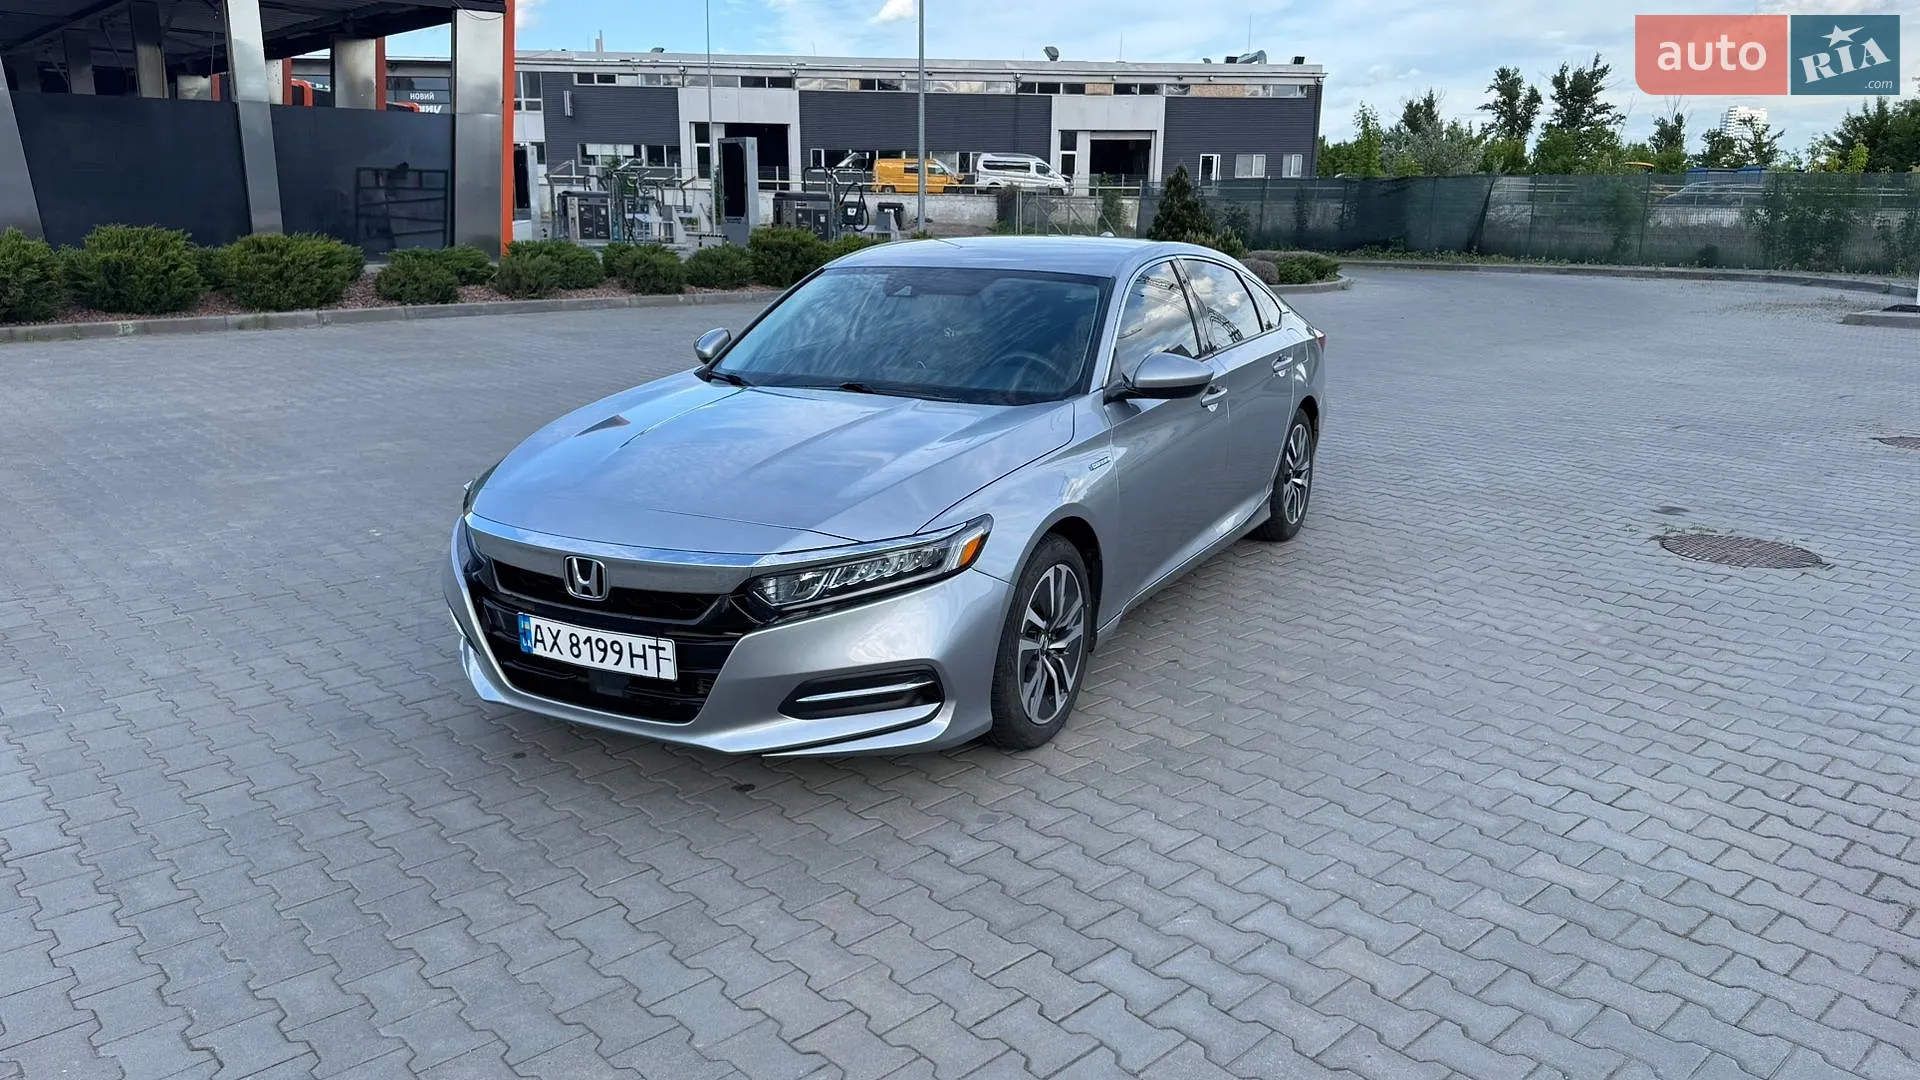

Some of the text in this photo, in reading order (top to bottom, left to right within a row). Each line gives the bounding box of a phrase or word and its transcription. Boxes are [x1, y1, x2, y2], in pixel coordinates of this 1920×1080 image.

[533, 624, 666, 673] AX 8199 HT
